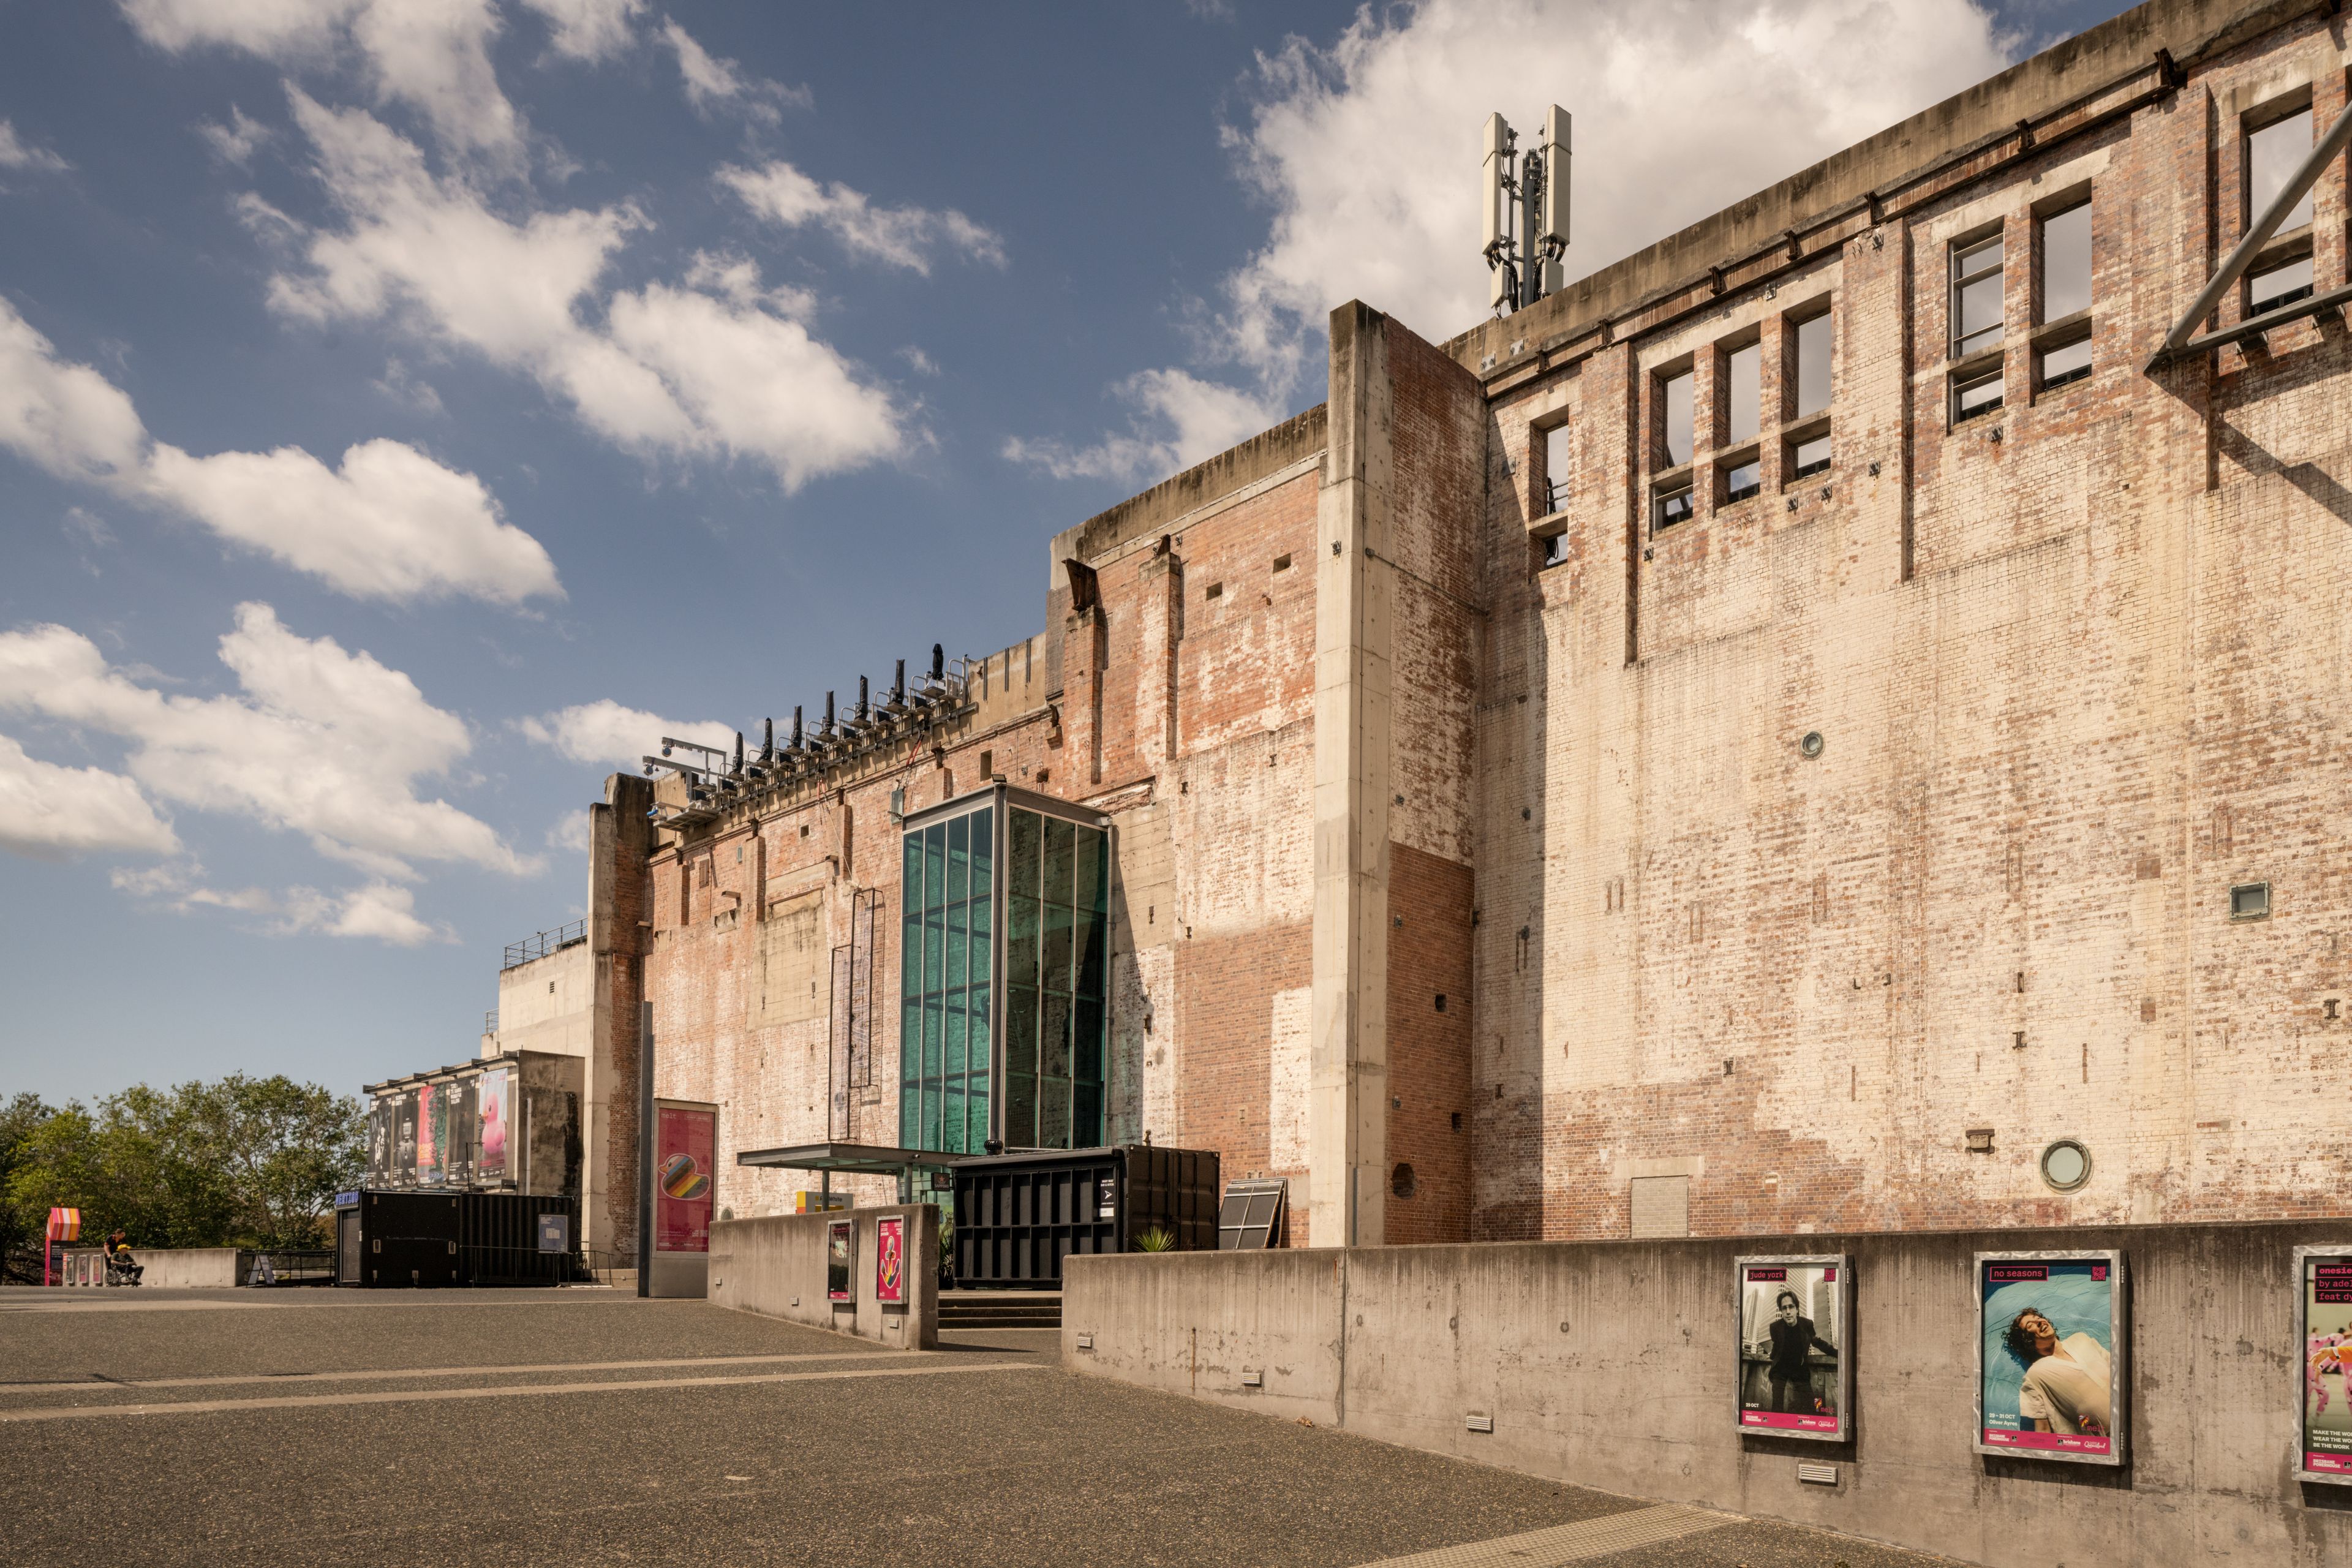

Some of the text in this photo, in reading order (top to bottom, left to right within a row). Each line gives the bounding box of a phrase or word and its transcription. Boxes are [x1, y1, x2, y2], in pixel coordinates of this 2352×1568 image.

[336, 1191, 358, 1205] VERTIGO
[1767, 1271, 1784, 1280] york
[2319, 1280, 2330, 1289] by
